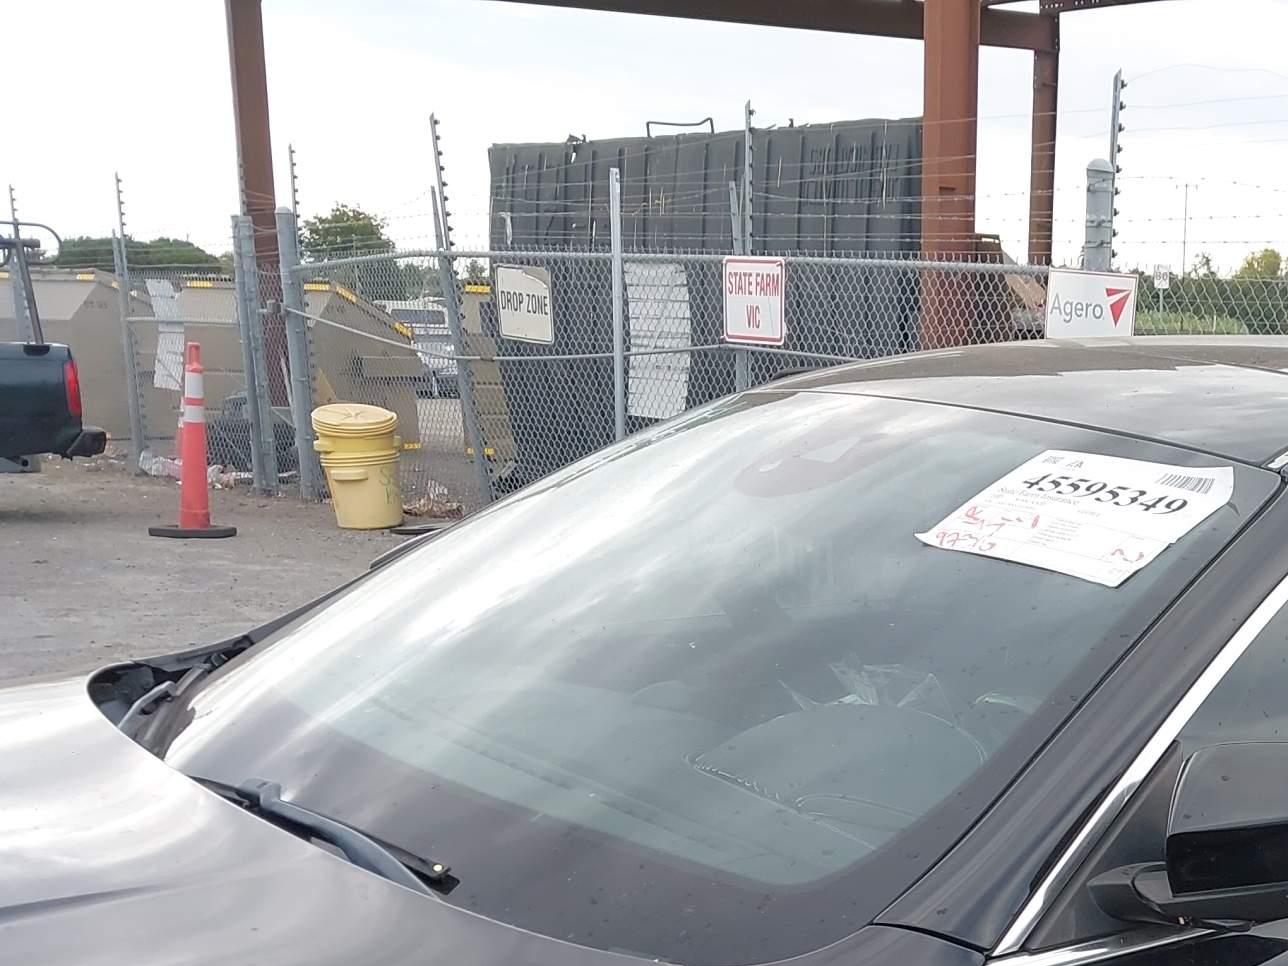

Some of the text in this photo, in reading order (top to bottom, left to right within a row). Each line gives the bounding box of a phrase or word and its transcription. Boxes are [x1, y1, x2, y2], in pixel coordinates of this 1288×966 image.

[728, 271, 780, 297] STATE FARM
[500, 290, 549, 316] DROP ZONE
[1050, 292, 1104, 324] Agero
[746, 304, 761, 329] VIC
[1021, 473, 1189, 515] 45595349
